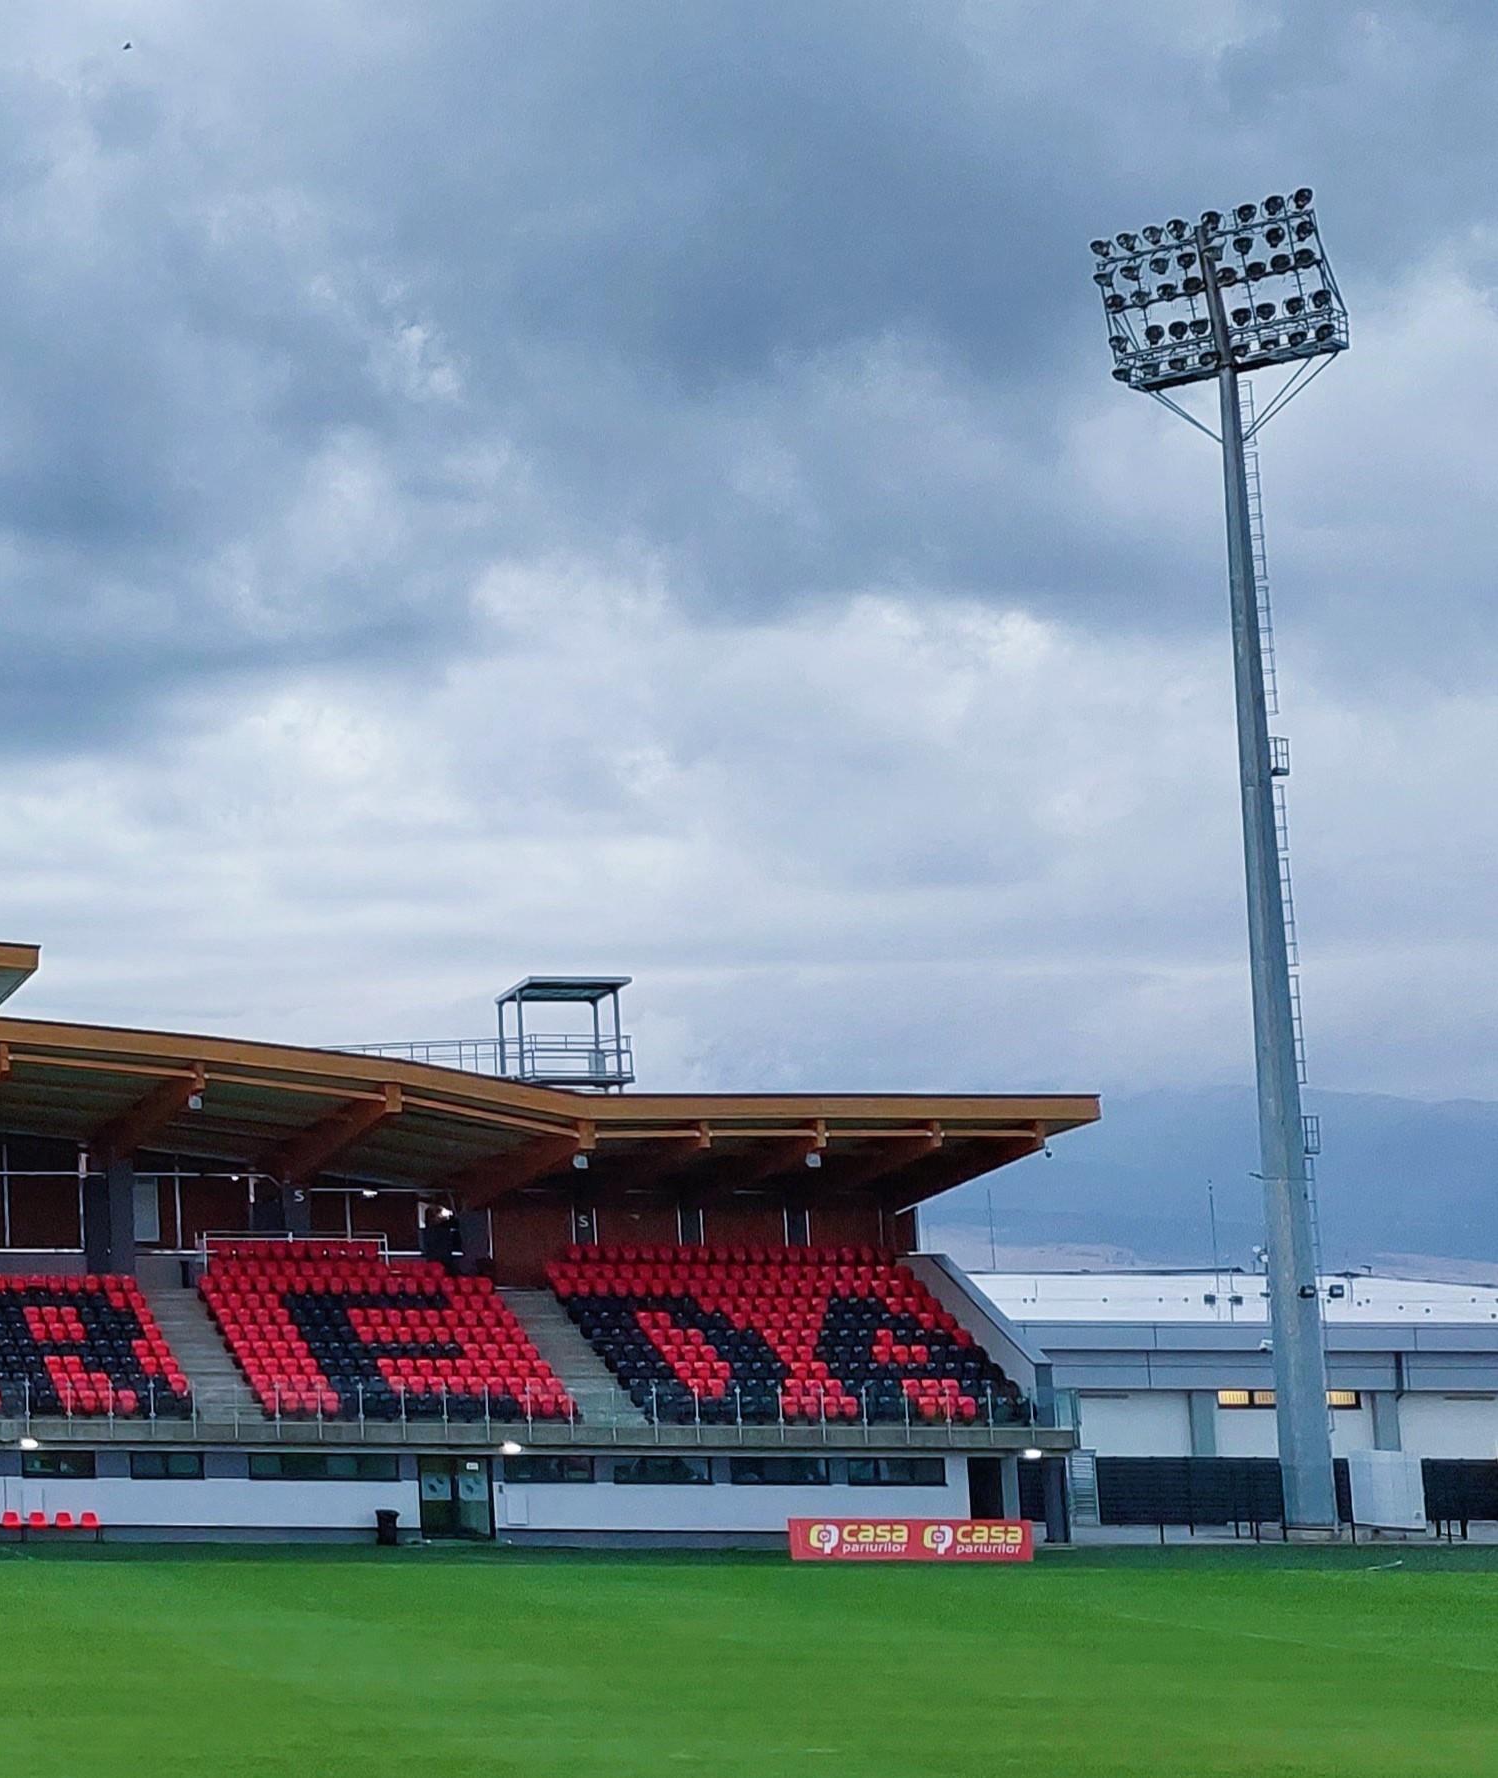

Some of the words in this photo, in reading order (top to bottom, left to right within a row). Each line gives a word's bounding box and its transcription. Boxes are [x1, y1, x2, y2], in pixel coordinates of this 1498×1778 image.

[294, 1189, 305, 1202] S
[842, 1524, 909, 1542] casa
[956, 1525, 1023, 1543] casa
[842, 1542, 908, 1554] pariurilor
[956, 1543, 1022, 1555] pariurilor
